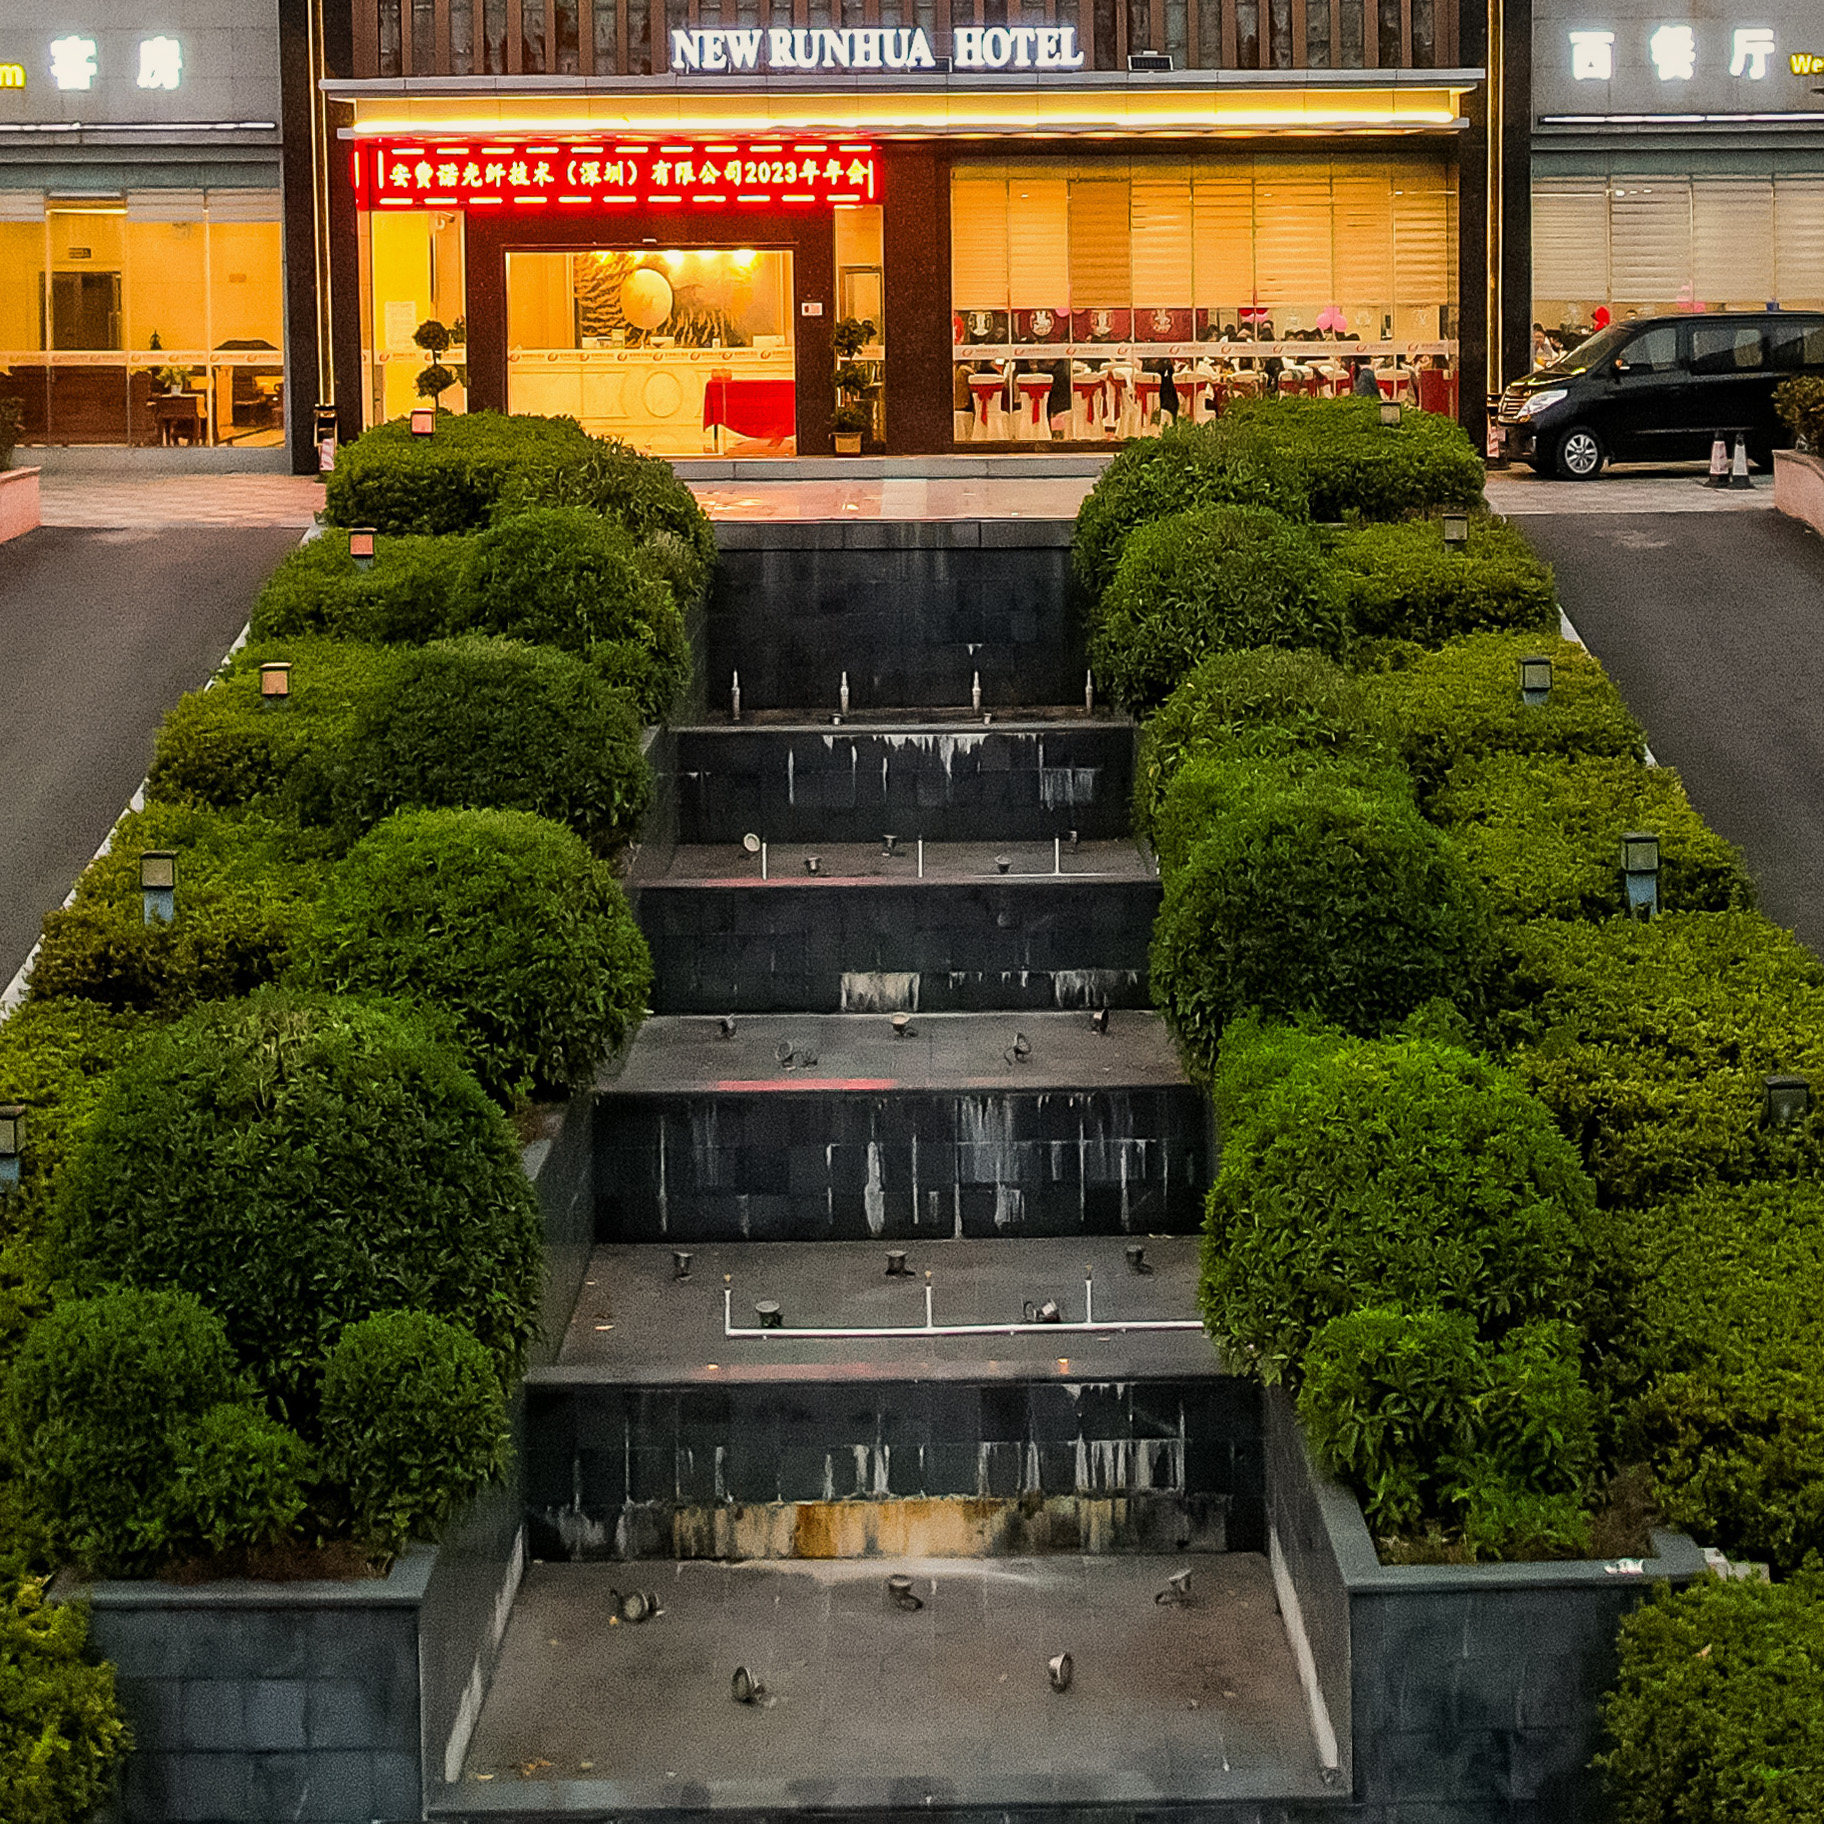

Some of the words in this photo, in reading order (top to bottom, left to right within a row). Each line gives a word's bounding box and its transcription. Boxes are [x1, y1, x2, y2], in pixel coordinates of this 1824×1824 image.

[671, 27, 764, 70] NEW
[768, 26, 935, 69] RUNHUA
[953, 26, 1085, 68] HOTEL
